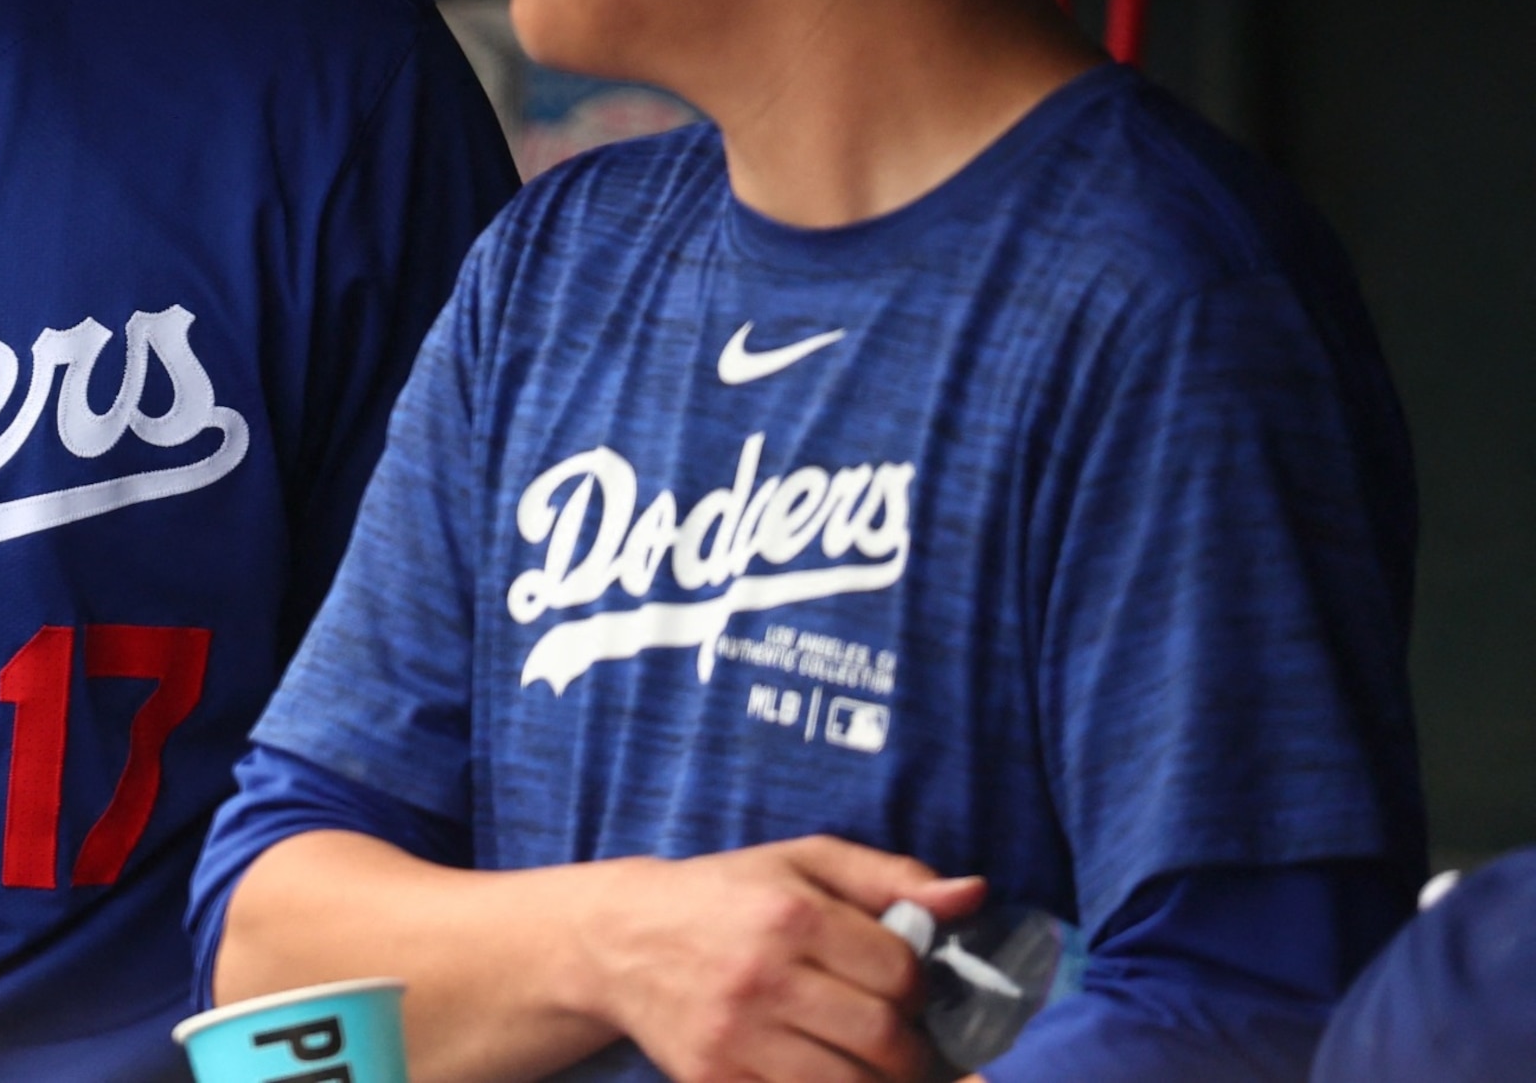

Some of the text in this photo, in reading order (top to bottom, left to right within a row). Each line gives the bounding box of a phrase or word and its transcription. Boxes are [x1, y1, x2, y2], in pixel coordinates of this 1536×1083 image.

[765, 624, 798, 649] LOS
[716, 634, 896, 695] AUTHENTIC COLLECTION
[746, 683, 803, 727] MLB
